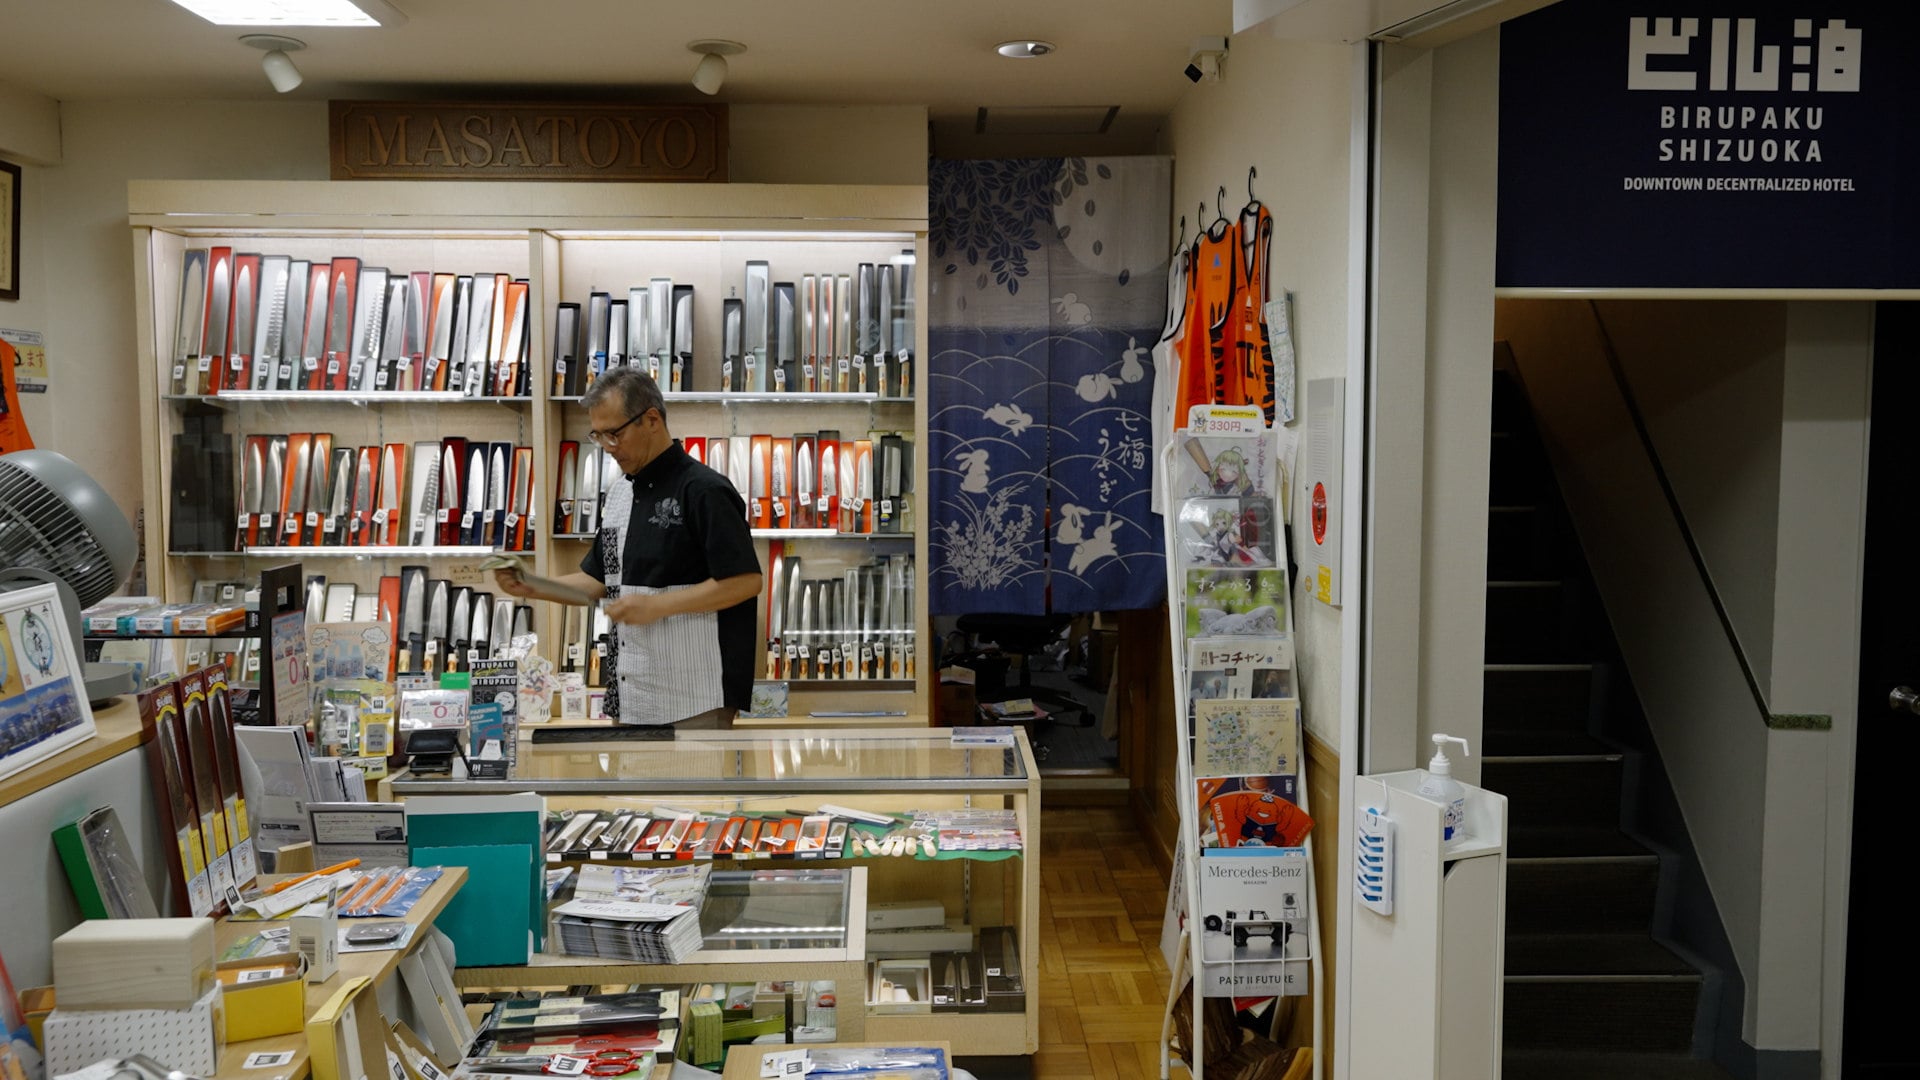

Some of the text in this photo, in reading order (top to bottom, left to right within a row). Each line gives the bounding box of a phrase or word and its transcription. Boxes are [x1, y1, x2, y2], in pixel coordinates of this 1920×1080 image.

[1660, 105, 1823, 130] BIRUPAKU
[361, 113, 698, 170] MASATOYO
[1658, 138, 1822, 163] SHIZUOKA
[1624, 177, 1855, 192] DOWNTOWN DECENTRALIZED HOTEL
[1209, 420, 1241, 432] 330円
[1208, 650, 1265, 666] トコチャン
[1208, 865, 1302, 878] Mercedes-Benz
[1219, 976, 1244, 985] PAST
